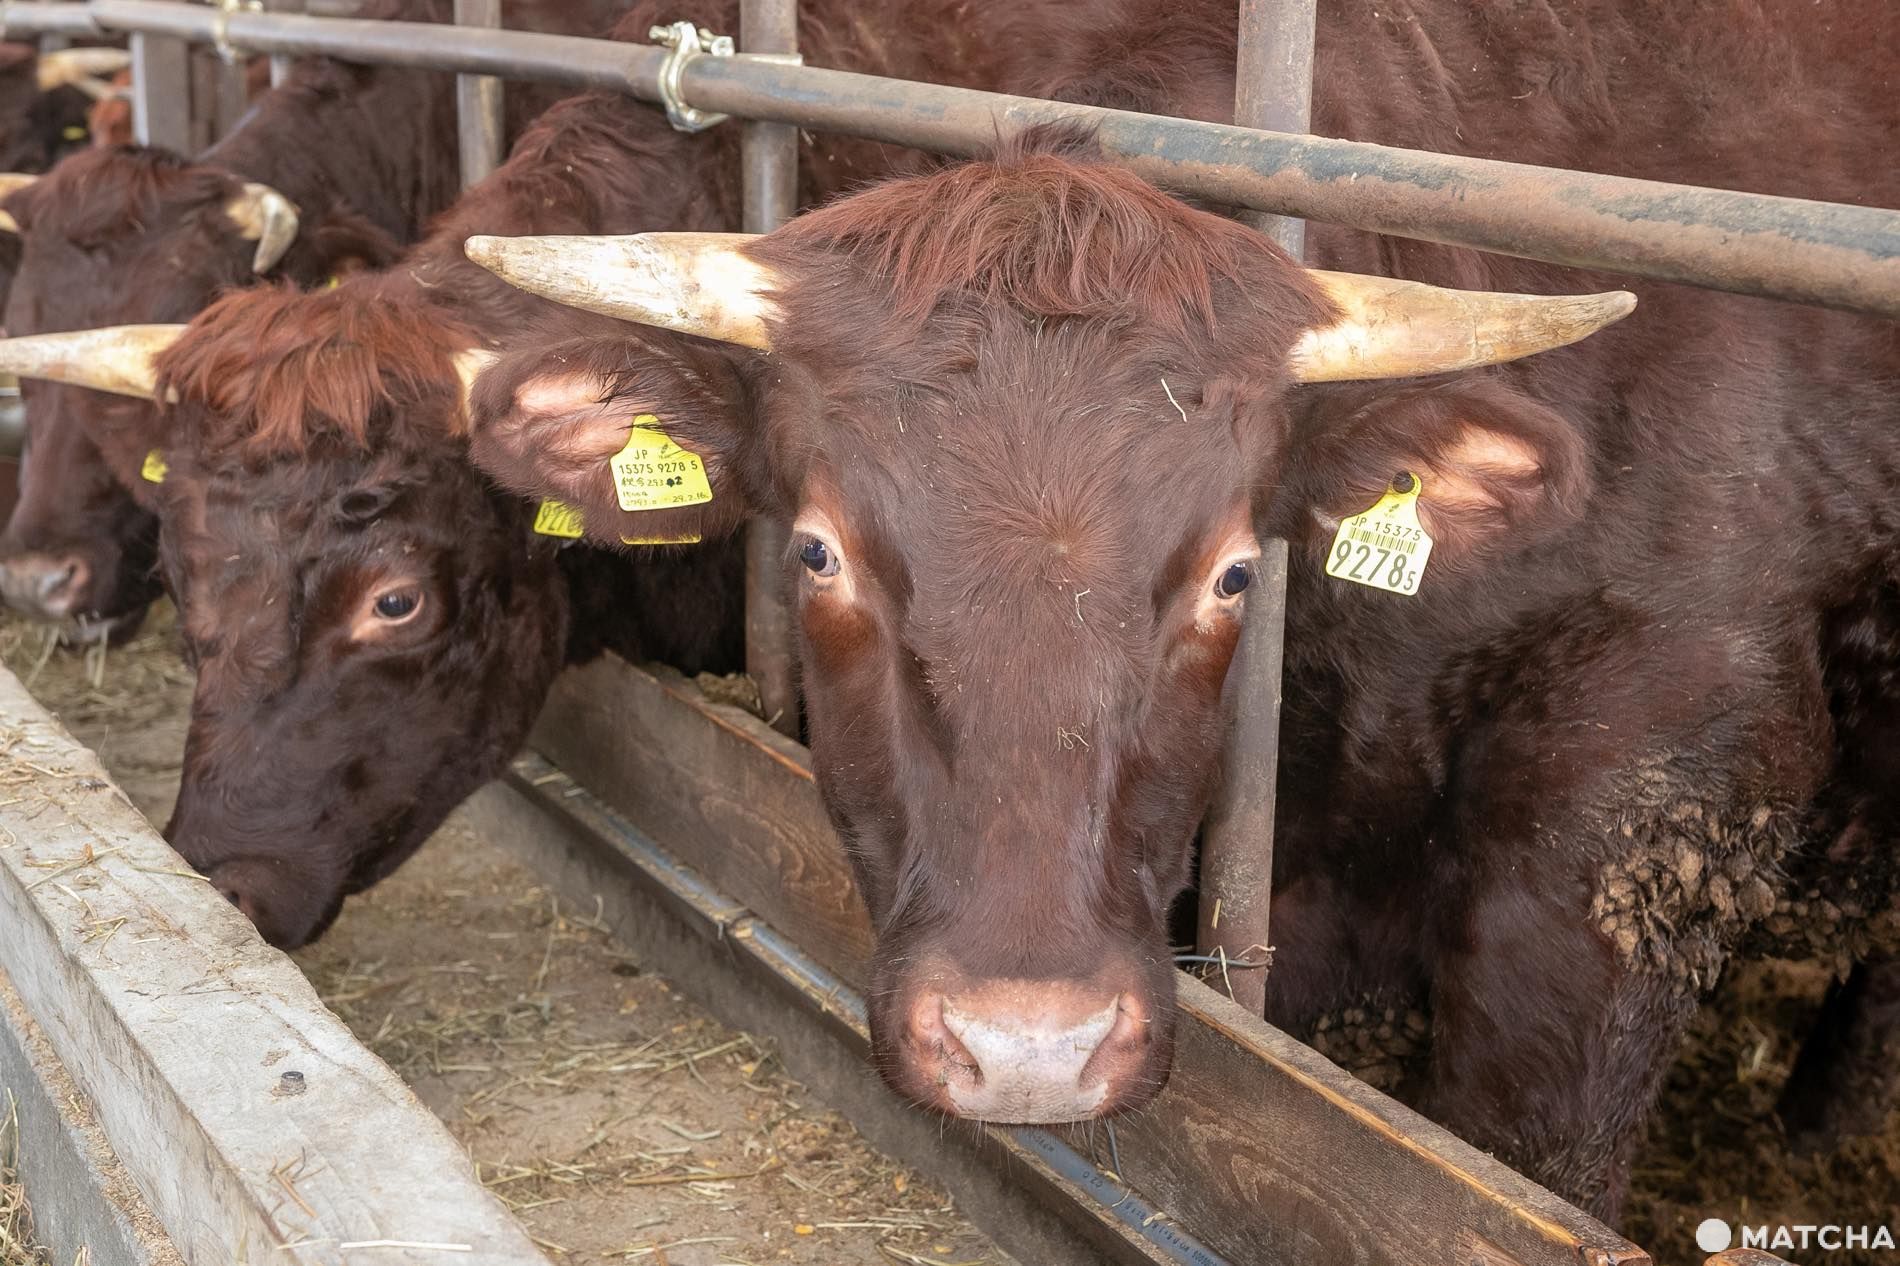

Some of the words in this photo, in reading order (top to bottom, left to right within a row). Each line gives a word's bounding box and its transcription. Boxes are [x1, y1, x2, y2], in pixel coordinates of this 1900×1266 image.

[634, 449, 648, 460] JP
[619, 463, 653, 475] 15375
[658, 462, 686, 473] 9278
[691, 460, 698, 470] 5
[1351, 516, 1368, 527] JP
[1374, 521, 1422, 541] 15375
